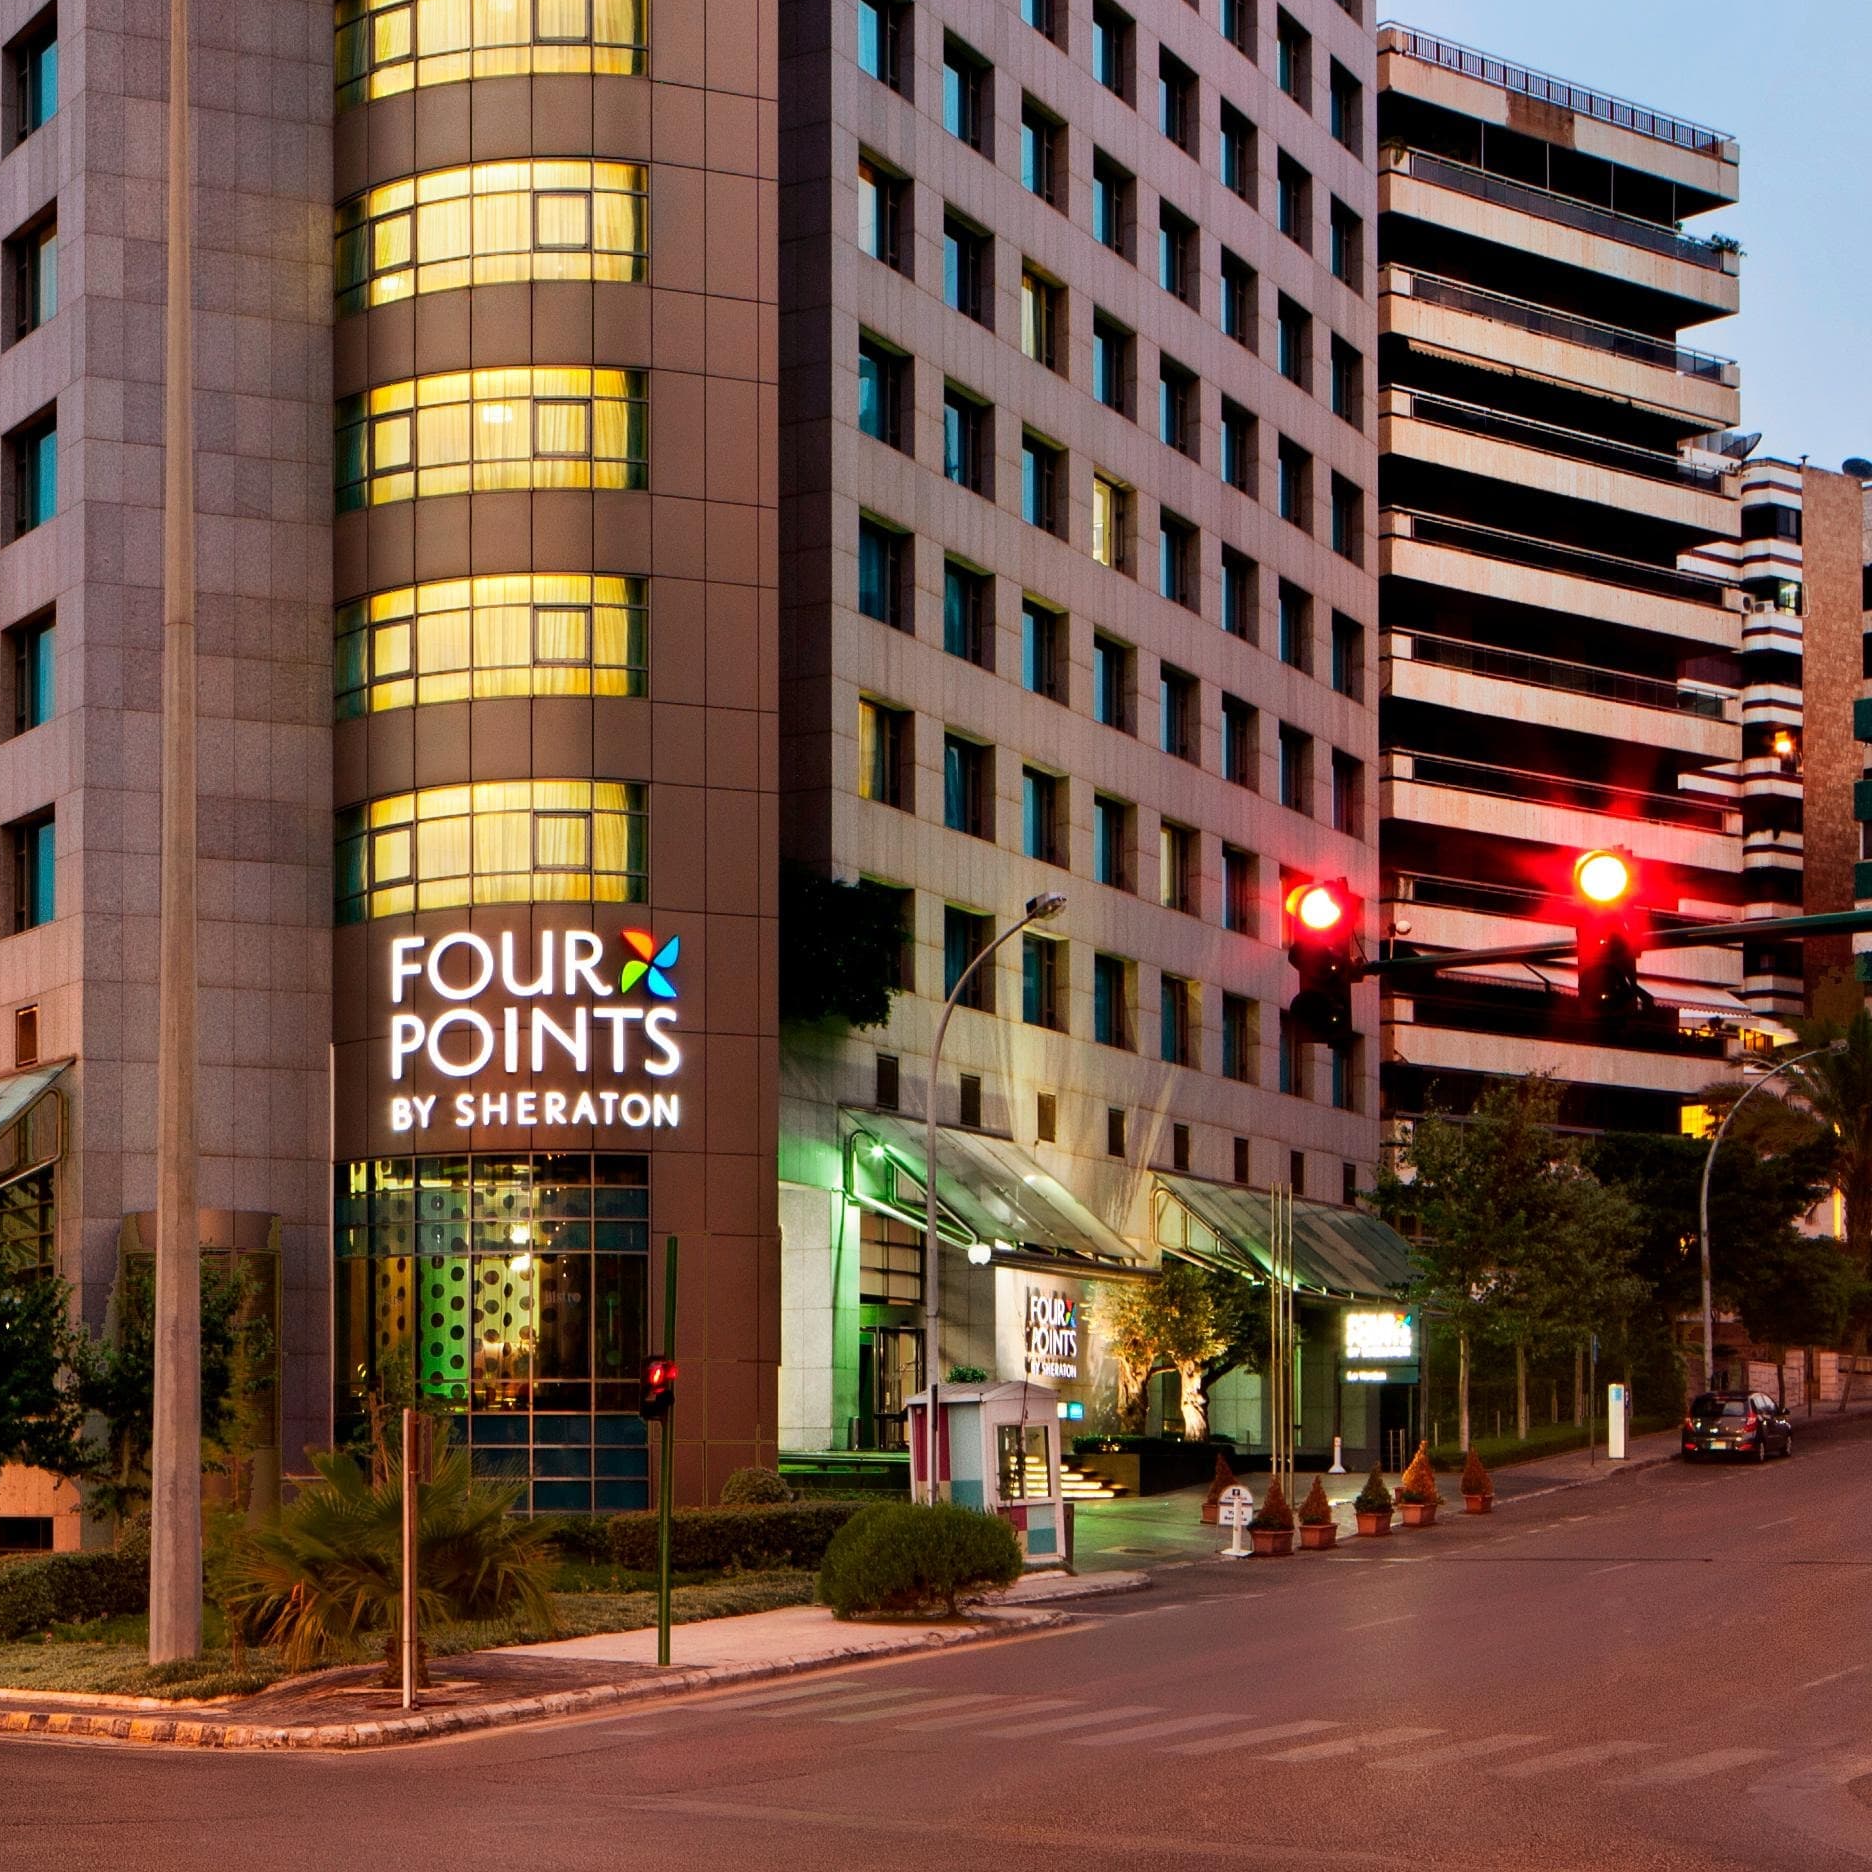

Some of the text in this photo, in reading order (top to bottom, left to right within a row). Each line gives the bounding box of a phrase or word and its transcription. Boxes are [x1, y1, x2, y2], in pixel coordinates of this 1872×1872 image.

[391, 929, 614, 1003] FOUR
[391, 1006, 682, 1080] POINTS
[391, 1092, 680, 1131] BY SHERATON
[1030, 1295, 1067, 1327] FOUR
[1031, 1326, 1077, 1358] POINTS
